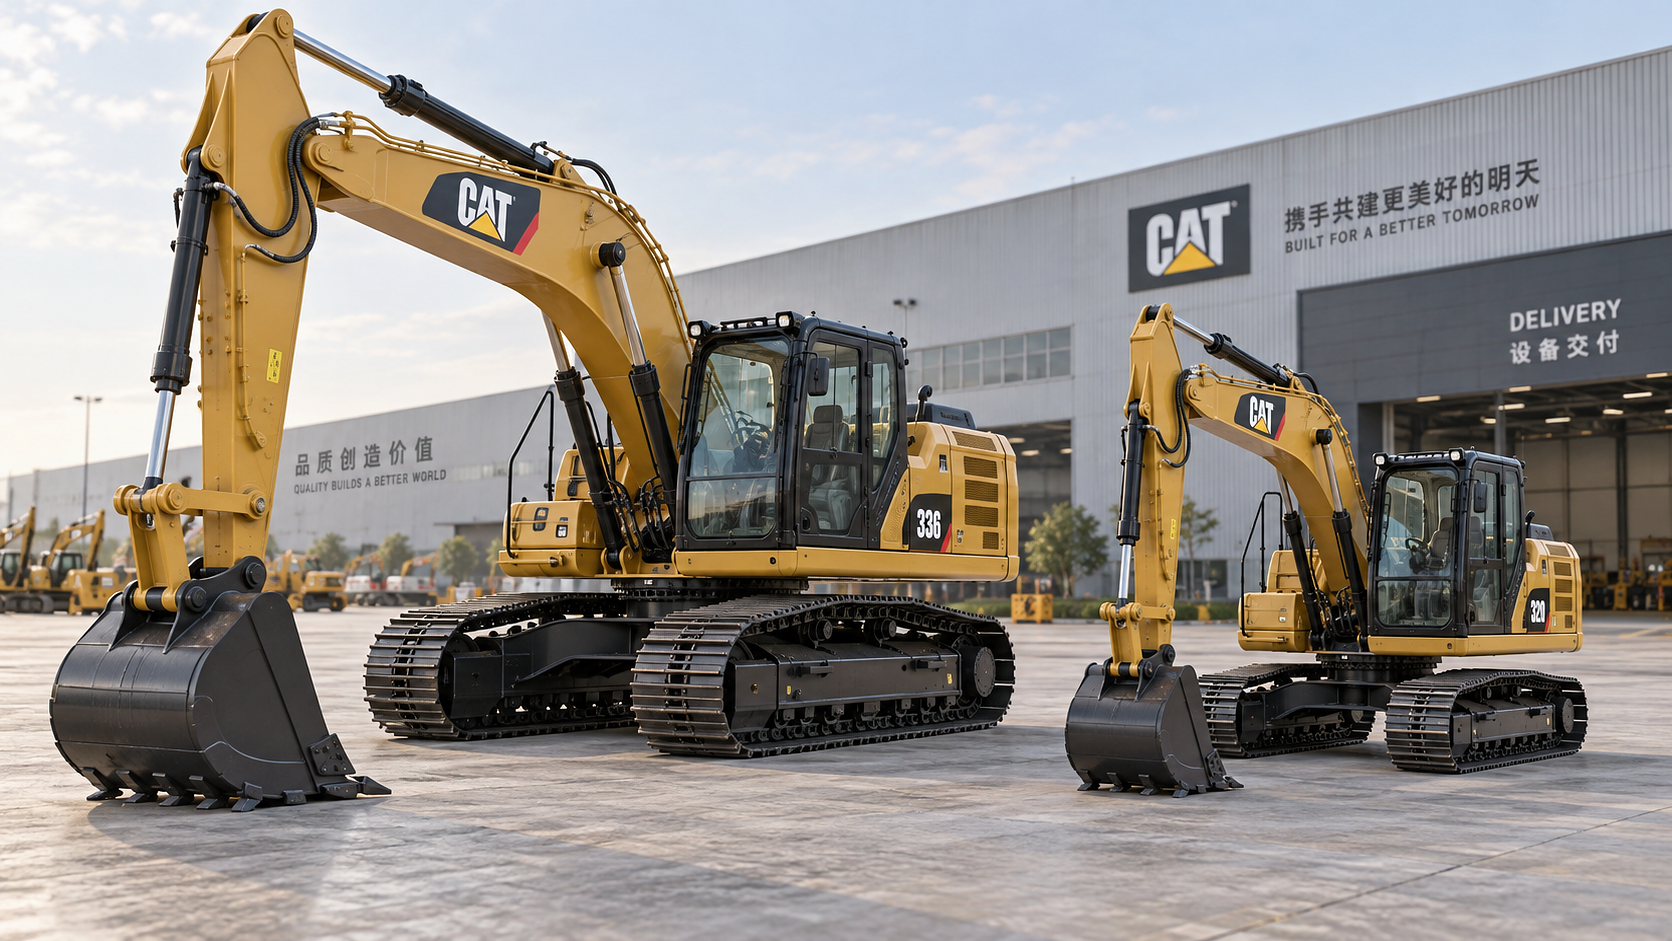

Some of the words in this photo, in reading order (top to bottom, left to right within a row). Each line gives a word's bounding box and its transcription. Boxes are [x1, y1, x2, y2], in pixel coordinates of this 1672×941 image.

[457, 177, 513, 242] CAT
[1285, 158, 1540, 233] 携手共建更美好的明天
[1146, 201, 1231, 277] CAT
[1285, 235, 1324, 254] BUILT
[1330, 229, 1358, 246] FOR
[1363, 226, 1373, 240] A
[1379, 213, 1436, 237] BETTER
[1442, 194, 1539, 224] TOMORROW
[1510, 298, 1621, 332] DELIVERY
[1509, 329, 1619, 365] 设备交付
[1249, 395, 1274, 435] CAT
[295, 436, 433, 477] 品质创造价值
[294, 481, 329, 495] QUALITY
[331, 477, 362, 491] BUILDS
[365, 477, 371, 488] A
[374, 473, 408, 487] BETTER
[412, 469, 447, 483] WORLD
[916, 508, 941, 540] 336
[1530, 599, 1546, 623] 320
